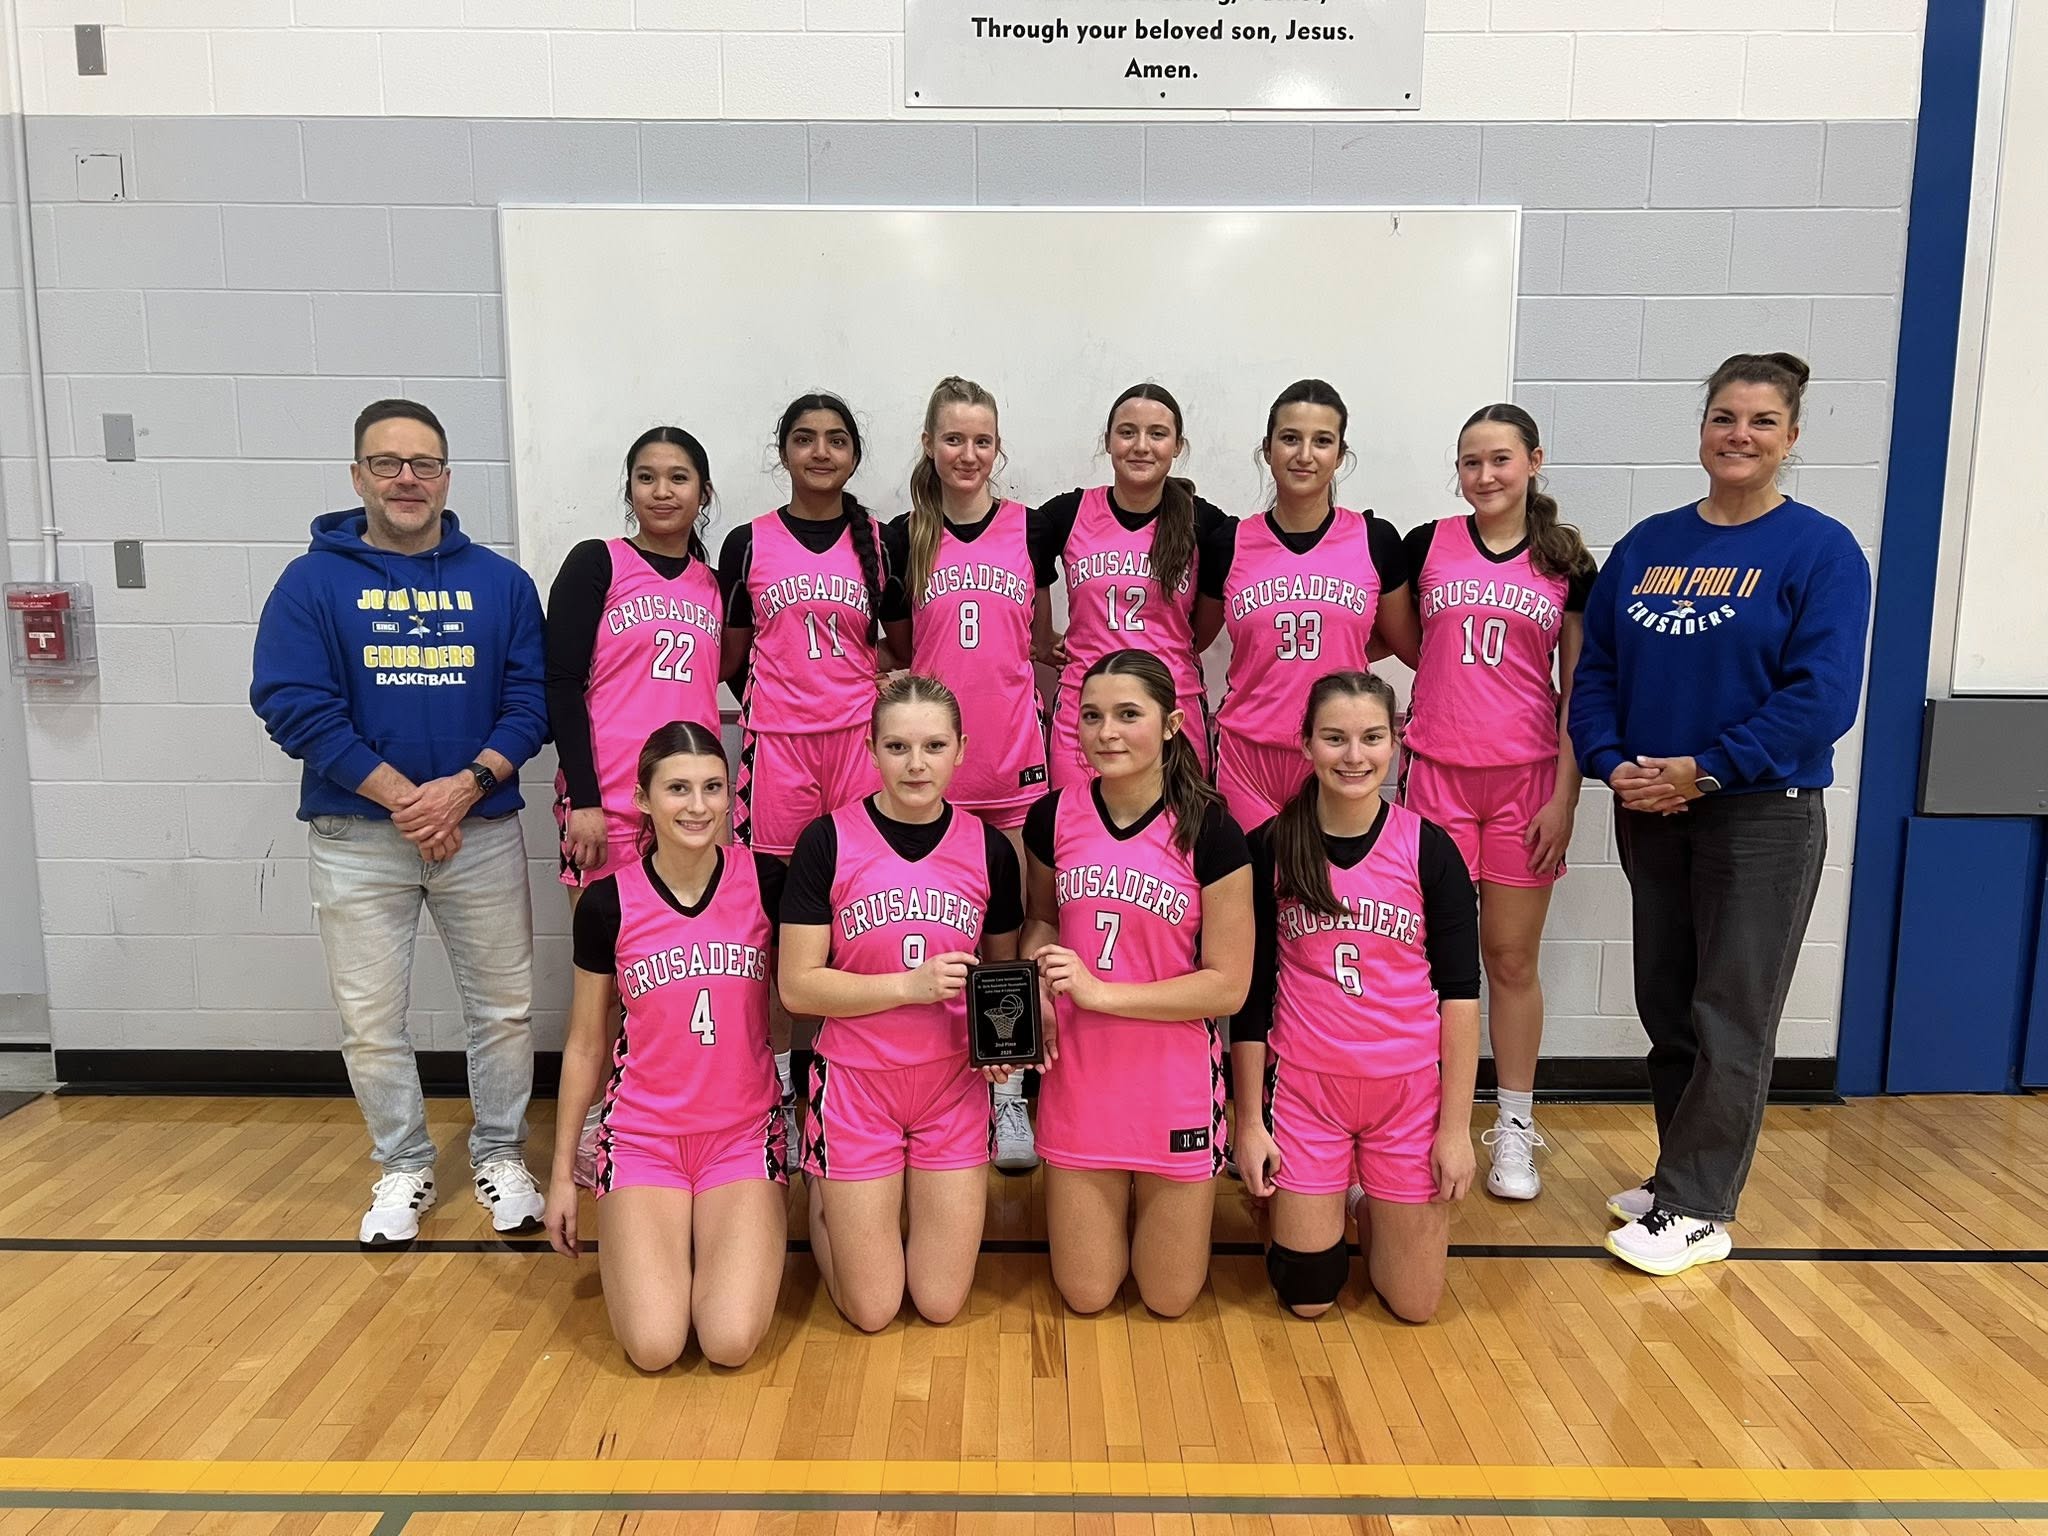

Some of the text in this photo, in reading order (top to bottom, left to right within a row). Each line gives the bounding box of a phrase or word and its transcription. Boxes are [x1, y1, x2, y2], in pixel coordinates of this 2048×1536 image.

[971, 18, 1354, 43] Through your beloved son, Jesus.
[1124, 58, 1198, 79] Amen.
[456, 591, 473, 610] II
[1231, 574, 1367, 621] CRUSADERS
[1423, 579, 1558, 632] CRUSADERS
[1632, 566, 1762, 598] JOHN PAUL II
[607, 595, 722, 648] CRUSADERS
[958, 600, 980, 649] 8
[1105, 585, 1147, 631] 12
[1627, 601, 1736, 635] CRUSADERS
[651, 628, 696, 684] 22
[804, 611, 846, 660] 11
[1274, 611, 1321, 661] 33
[1461, 615, 1507, 667] 10
[376, 672, 466, 686] BASKETBALL
[839, 886, 980, 941] CRUSADERS
[1095, 911, 1121, 971] 7
[623, 941, 767, 1001] CRUSADERS
[1333, 942, 1363, 997] 6
[689, 988, 716, 1046] 4
[1685, 1222, 1715, 1247] HOKA
